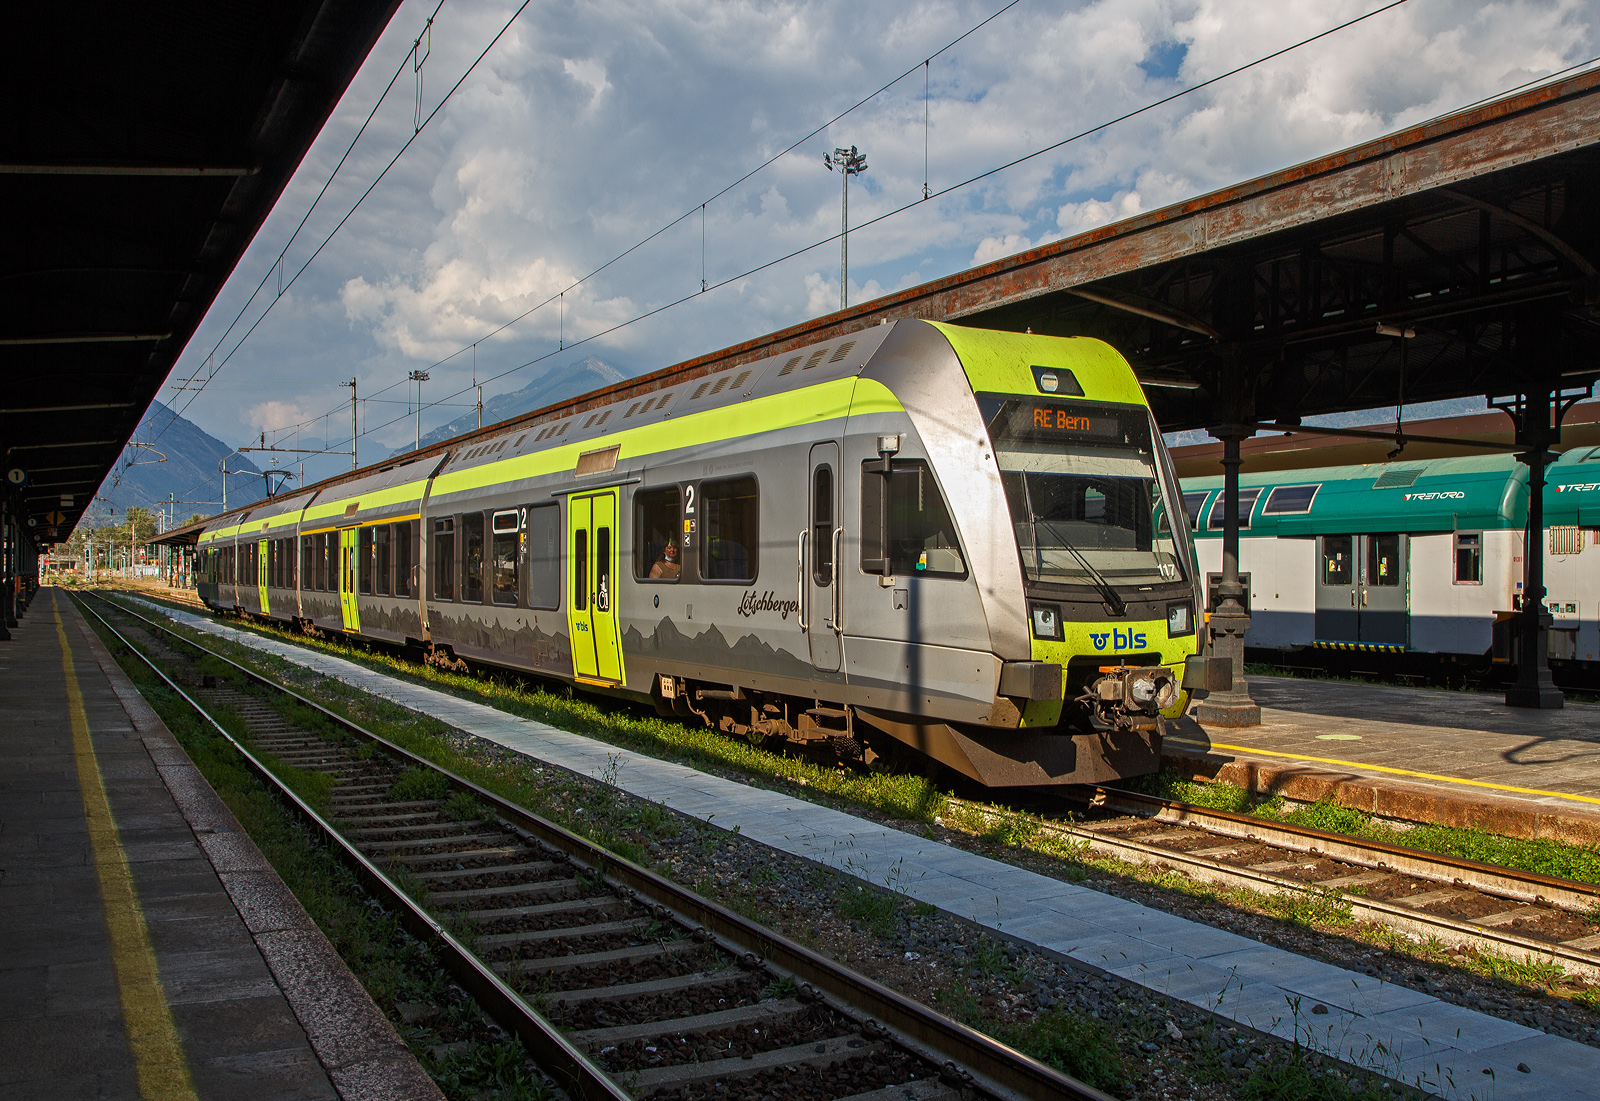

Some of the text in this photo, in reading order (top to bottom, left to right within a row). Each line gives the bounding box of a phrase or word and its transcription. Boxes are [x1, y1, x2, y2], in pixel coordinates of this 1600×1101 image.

[1033, 408, 1090, 431] RE Bern
[685, 484, 695, 514] 2
[1412, 491, 1465, 501] TRENORD
[520, 507, 527, 529] 2
[1157, 563, 1176, 577] 117
[1112, 627, 1148, 650] bls
